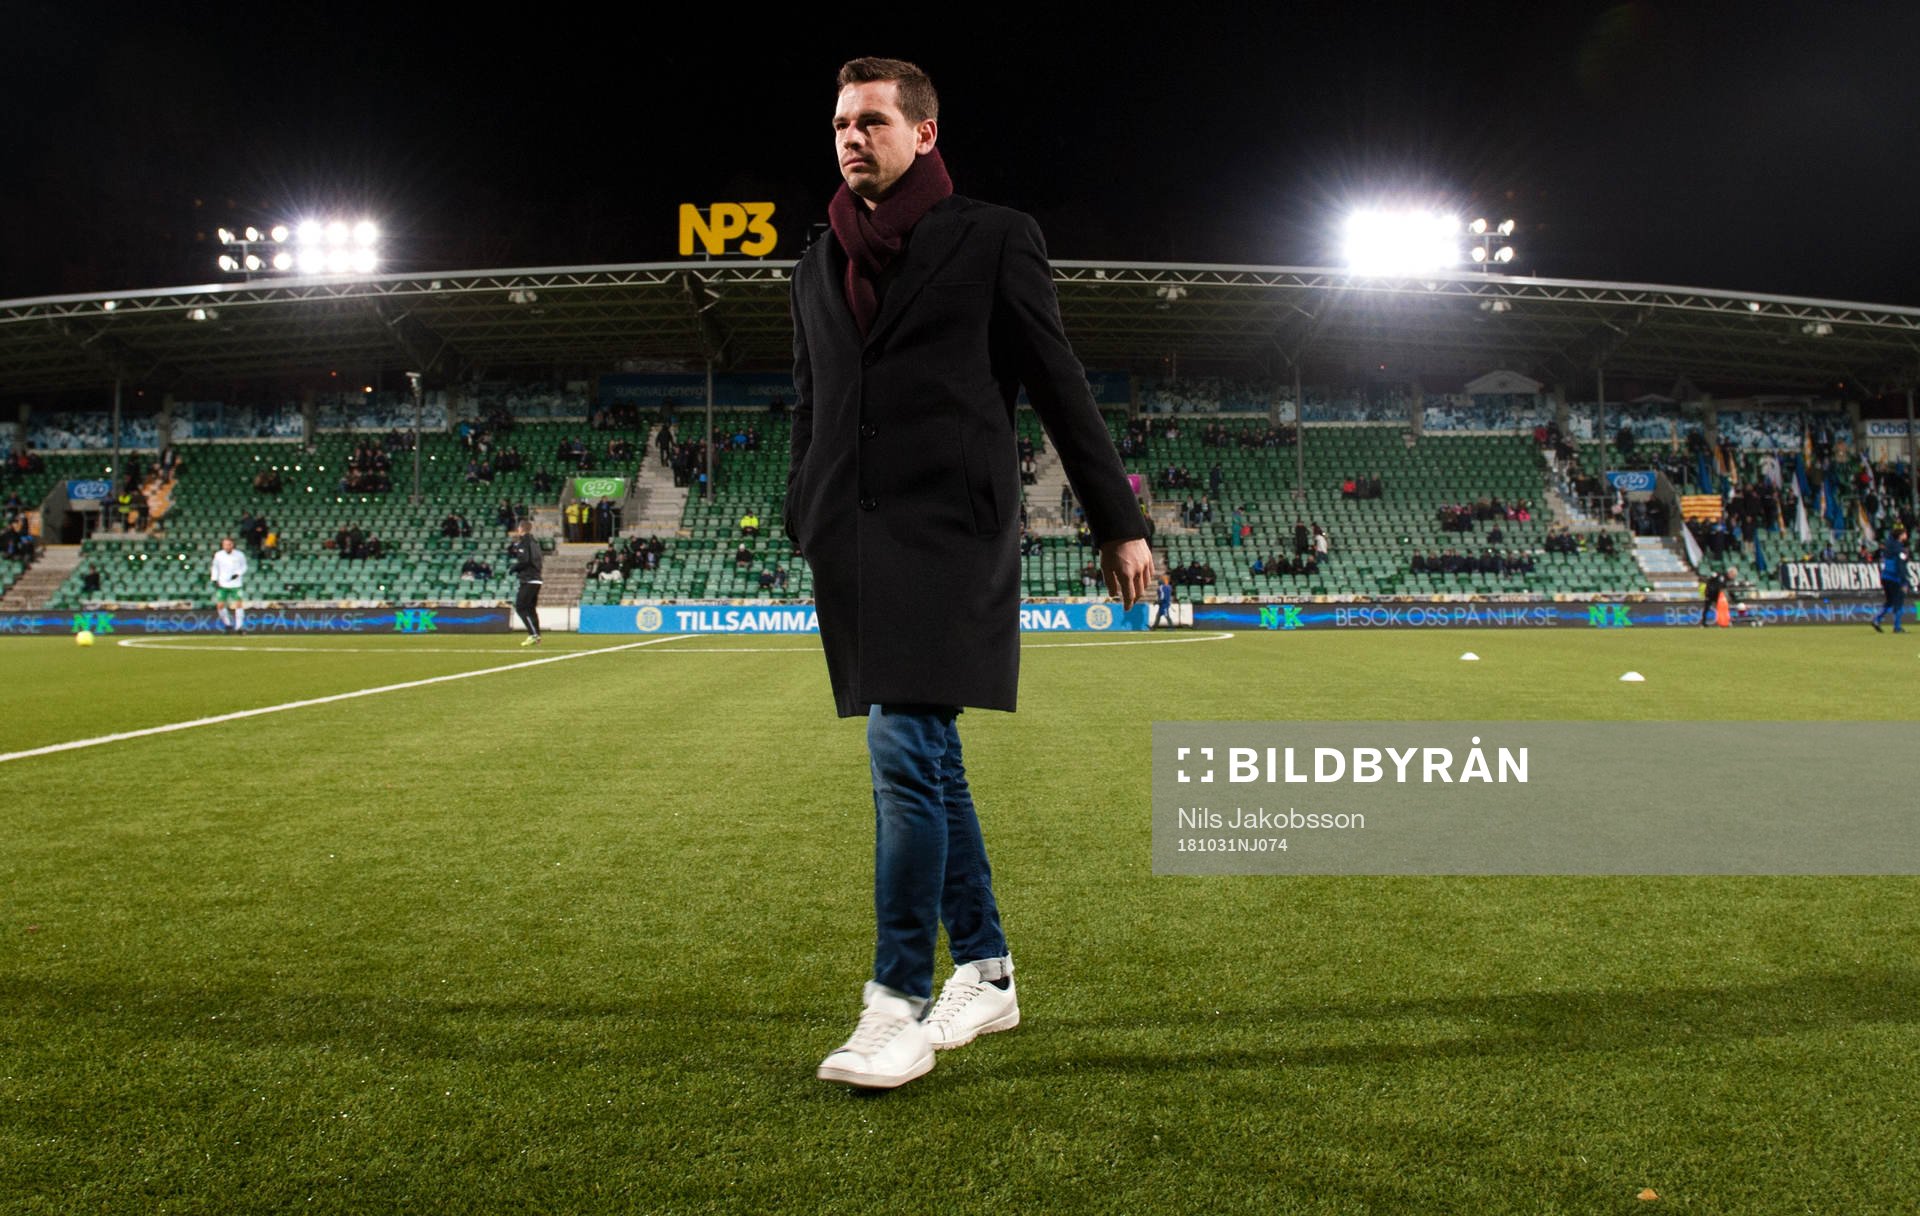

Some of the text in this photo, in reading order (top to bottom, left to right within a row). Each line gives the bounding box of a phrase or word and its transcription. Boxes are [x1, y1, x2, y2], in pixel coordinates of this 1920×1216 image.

[679, 202, 778, 257] NP3
[1787, 562, 1882, 590] PATRONERN
[676, 611, 819, 631] TILLSAMMA
[1335, 603, 1557, 626] BESÖK OSS PÅ NHK.SE
